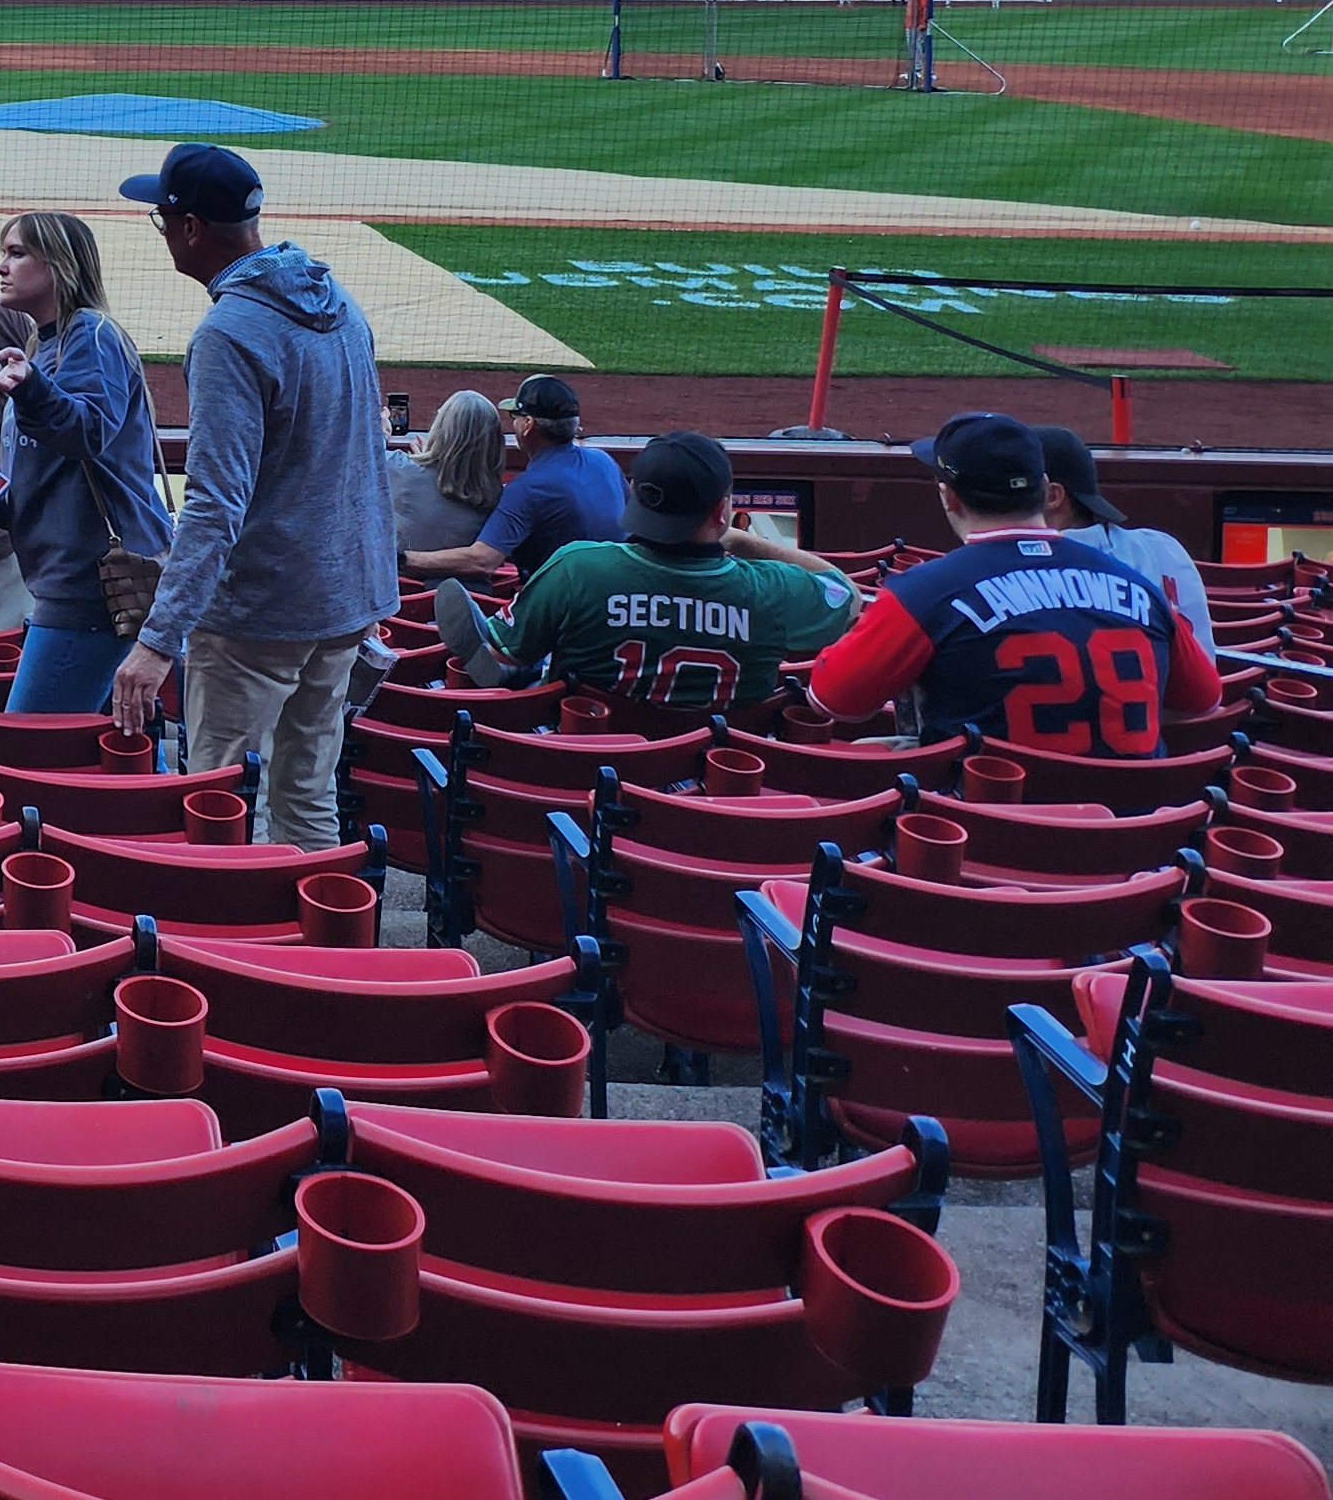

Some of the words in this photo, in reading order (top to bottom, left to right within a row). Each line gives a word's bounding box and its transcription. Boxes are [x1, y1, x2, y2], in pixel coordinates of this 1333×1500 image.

[606, 593, 750, 642] SECTION
[950, 568, 1151, 634] LAWNMOWER
[611, 639, 741, 711] 10
[995, 627, 1160, 754] 28
